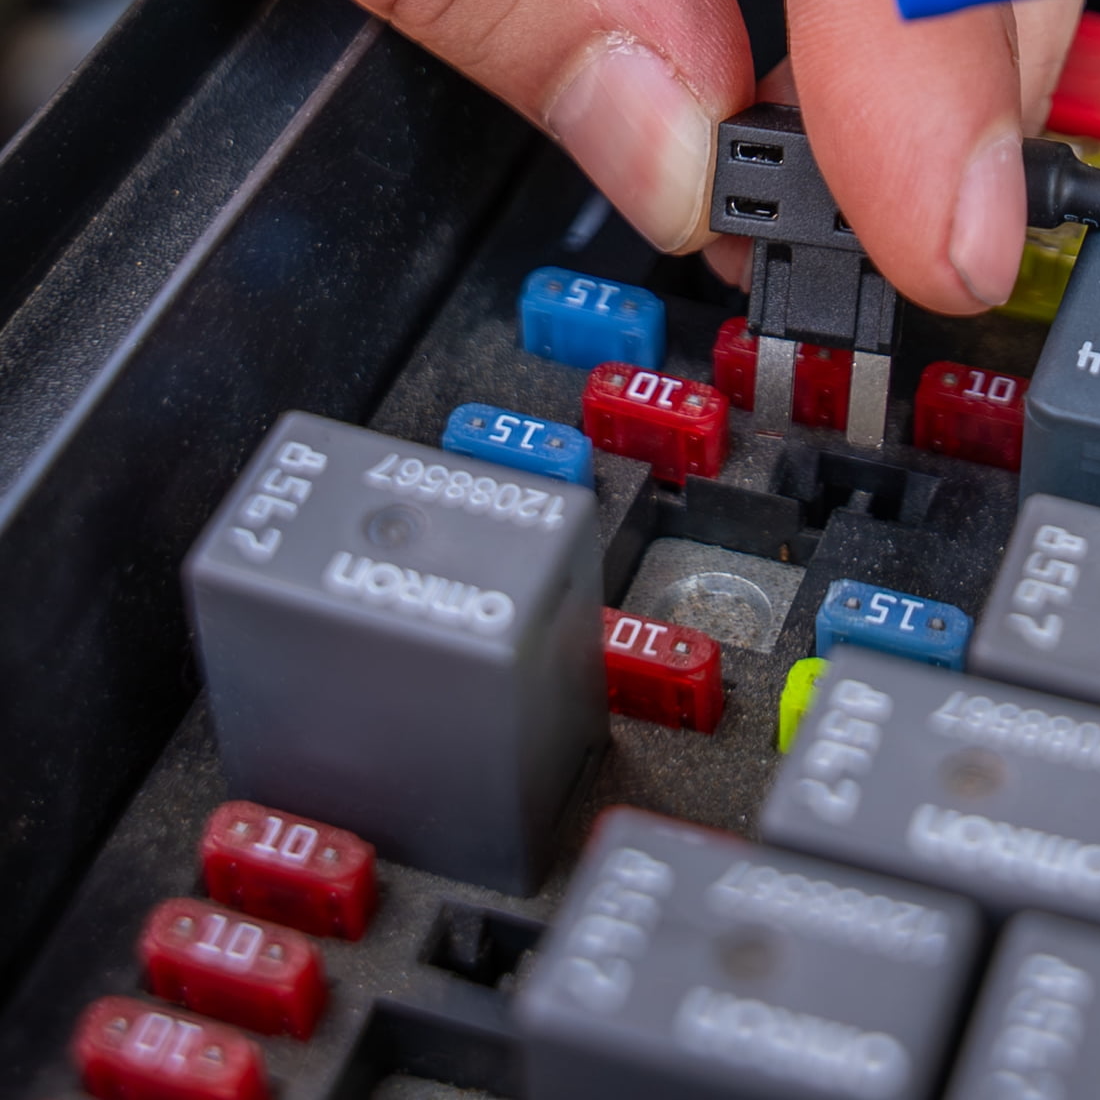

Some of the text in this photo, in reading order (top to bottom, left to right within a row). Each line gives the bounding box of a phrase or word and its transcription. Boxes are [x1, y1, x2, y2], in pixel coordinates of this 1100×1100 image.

[565, 278, 620, 312] 15
[626, 371, 682, 408] 10
[962, 371, 1016, 404] 10
[489, 414, 545, 449] 15
[232, 442, 327, 562] 8567
[365, 452, 565, 530] 12088567
[1006, 524, 1087, 650] 8567
[864, 592, 924, 631] 15
[609, 617, 667, 655] 10
[253, 816, 318, 864] 10
[194, 913, 264, 966] 10
[128, 1012, 203, 1073] 10
